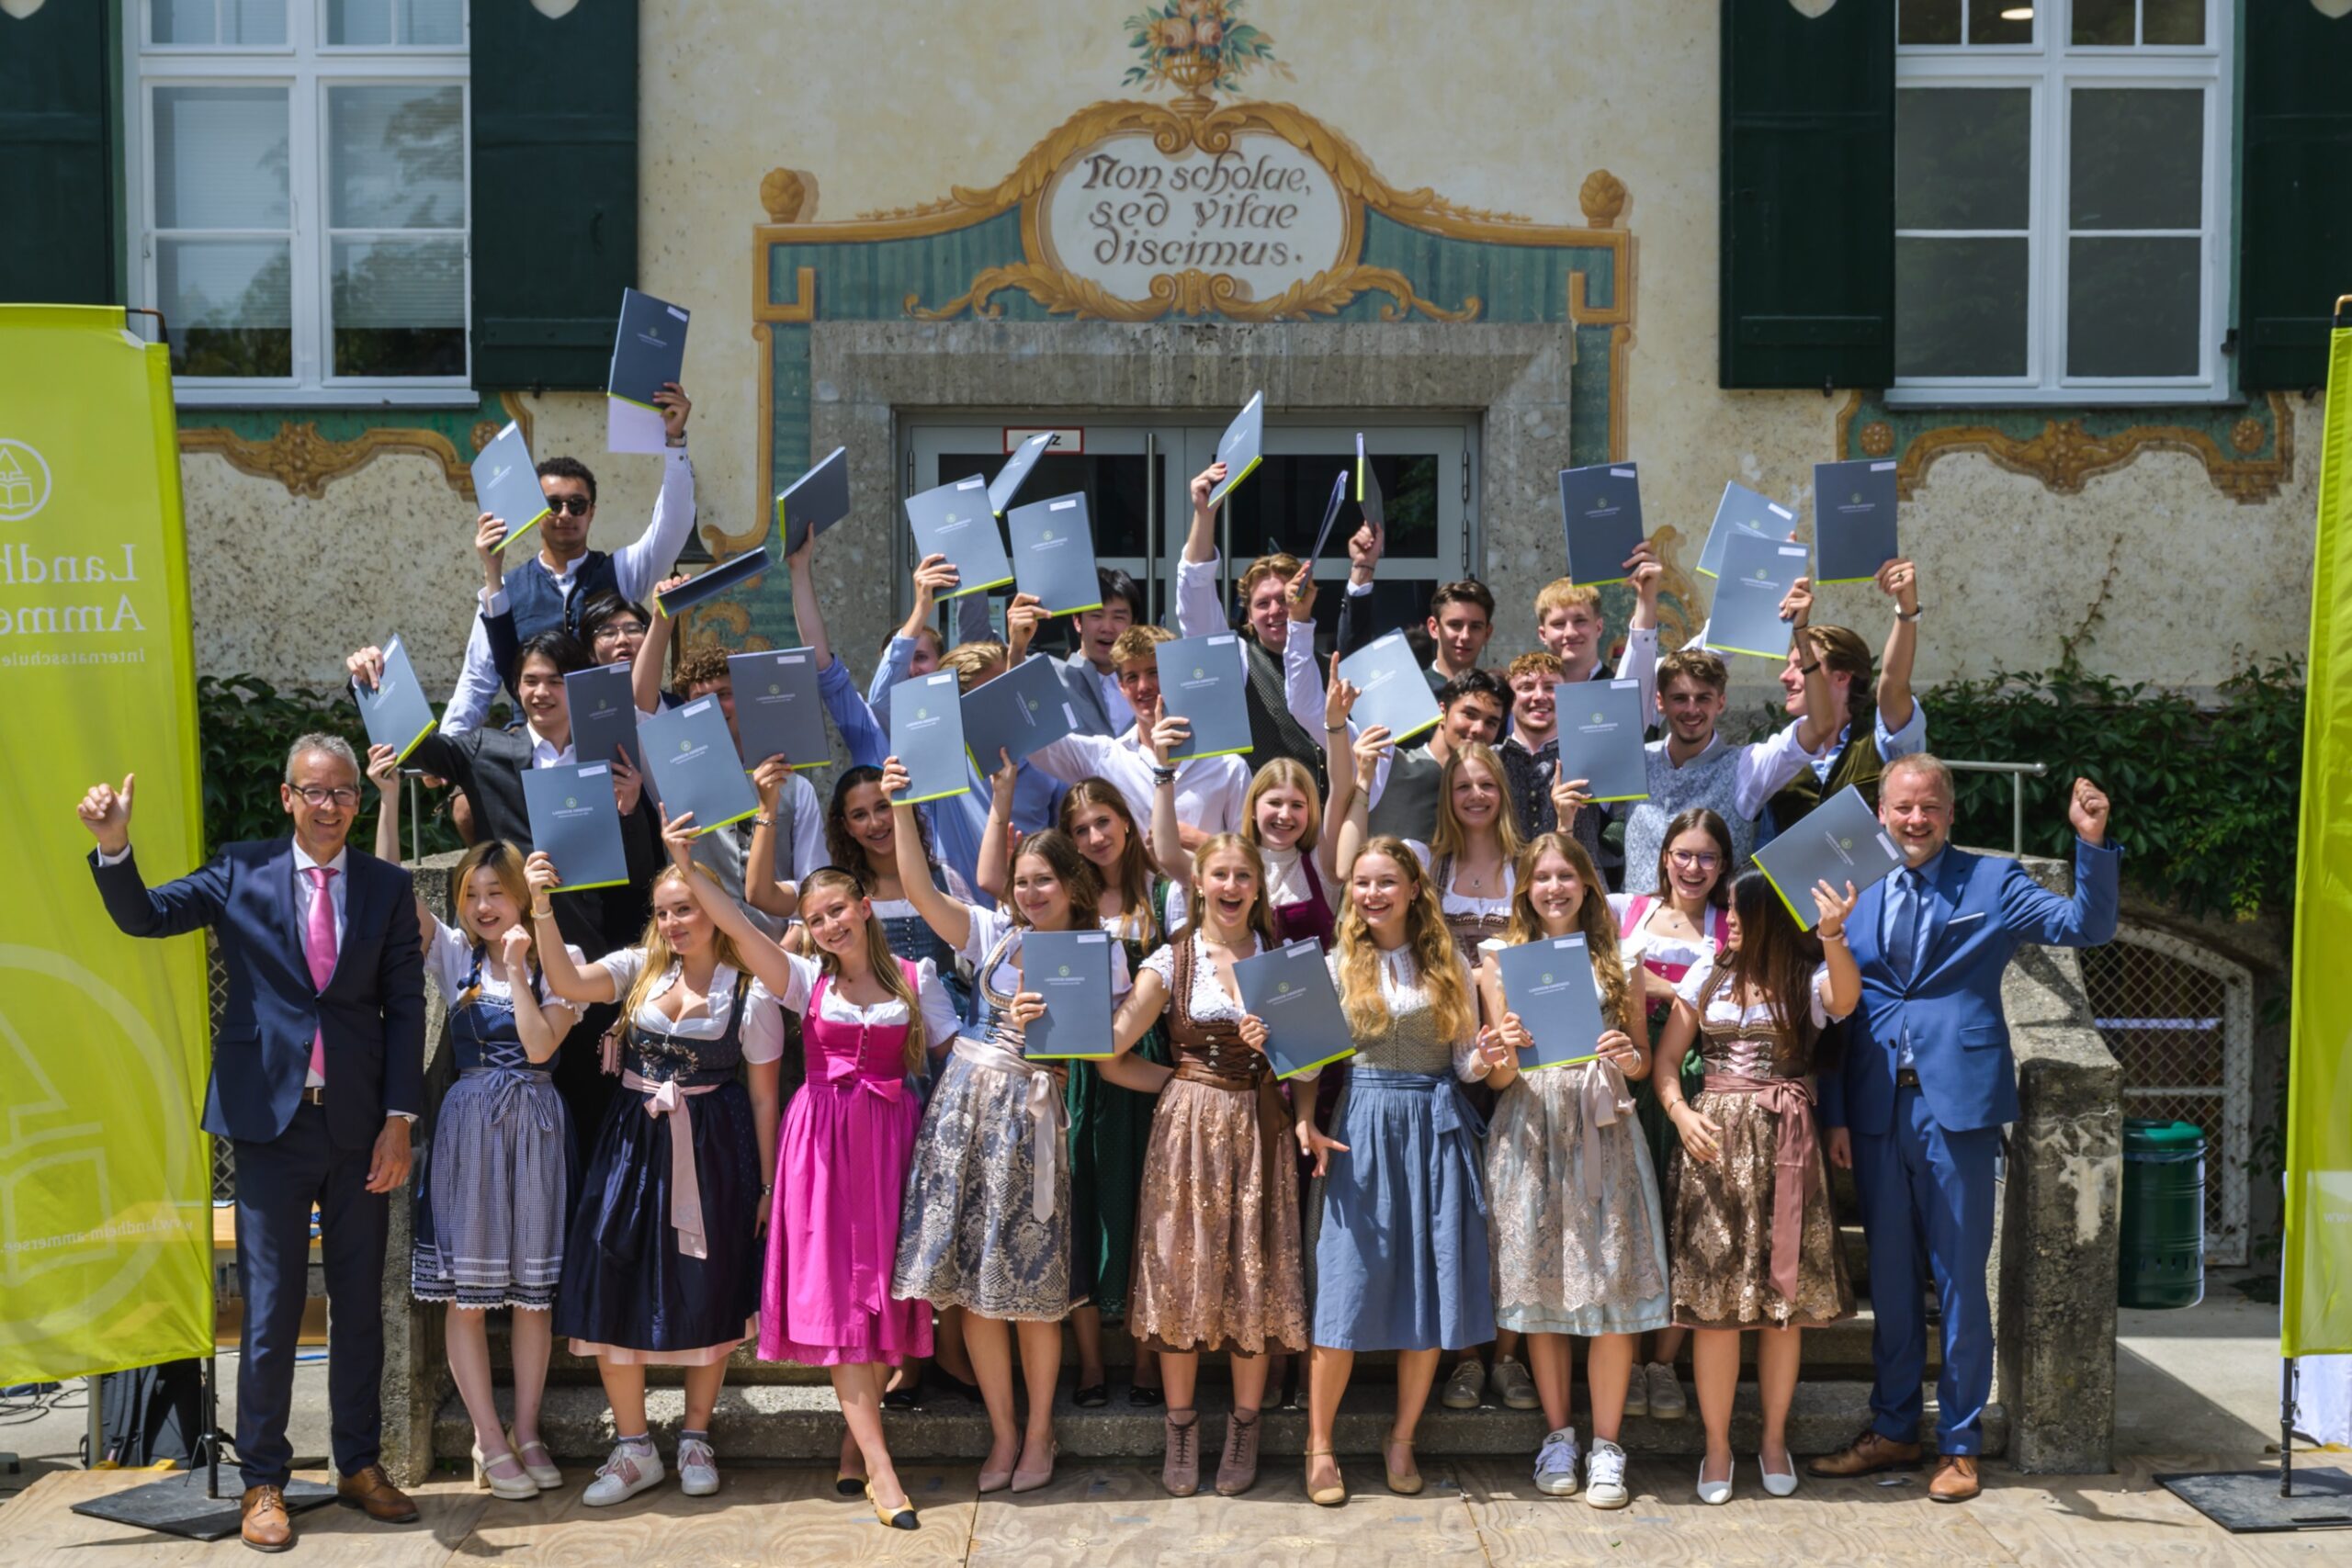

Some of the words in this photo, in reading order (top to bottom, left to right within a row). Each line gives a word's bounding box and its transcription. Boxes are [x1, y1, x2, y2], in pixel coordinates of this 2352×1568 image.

[1081, 153, 1163, 192] Non
[1169, 151, 1312, 196] scholae,
[1089, 192, 1170, 230] sed
[1093, 227, 1304, 267] discimus.
